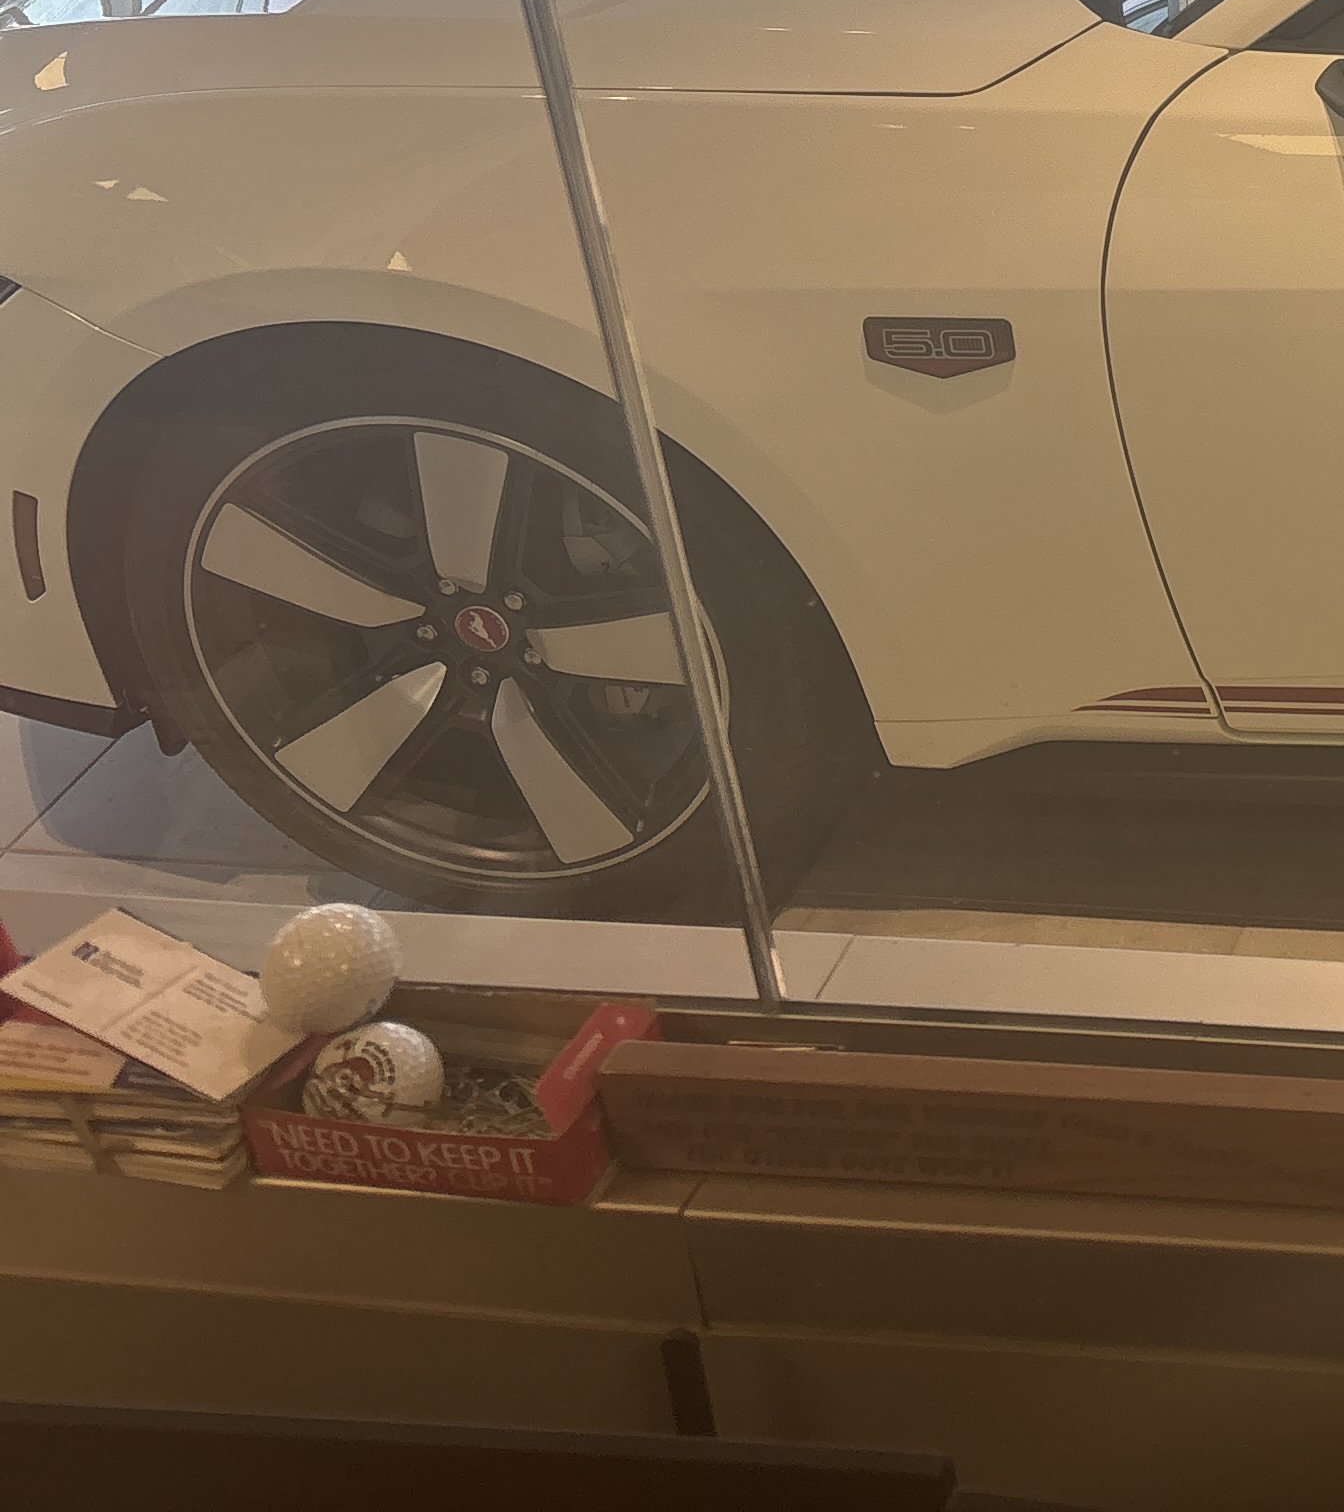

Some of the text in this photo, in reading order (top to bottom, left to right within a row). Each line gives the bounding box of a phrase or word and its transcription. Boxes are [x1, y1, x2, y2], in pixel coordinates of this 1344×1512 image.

[882, 328, 995, 359] 5.0
[269, 1122, 536, 1175] NEED TO KEEP IT
